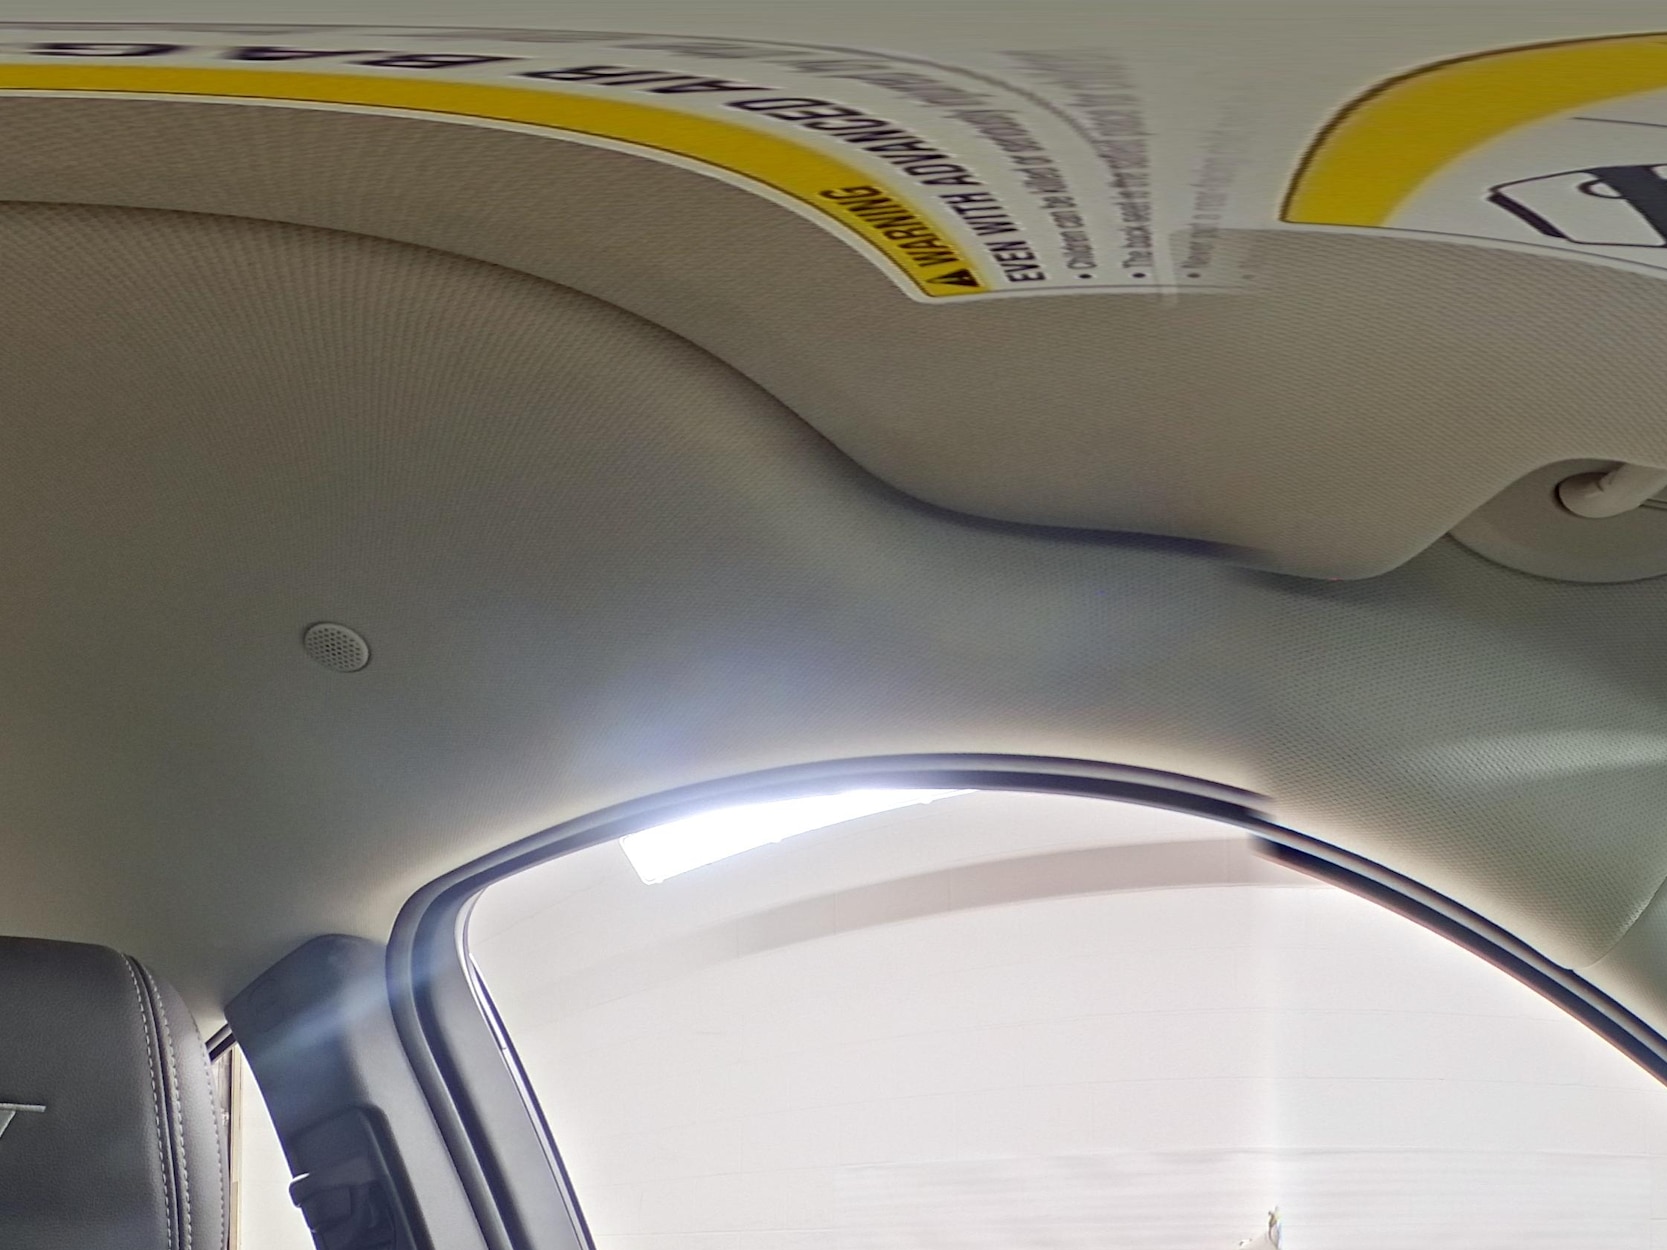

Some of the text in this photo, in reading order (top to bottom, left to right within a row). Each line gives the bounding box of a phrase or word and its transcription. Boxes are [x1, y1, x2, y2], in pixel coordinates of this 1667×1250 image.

[726, 97, 981, 185] ADVANCED
[819, 184, 959, 267] WARNING
[938, 191, 1018, 236] WITH
[984, 240, 1045, 282] EVEN
